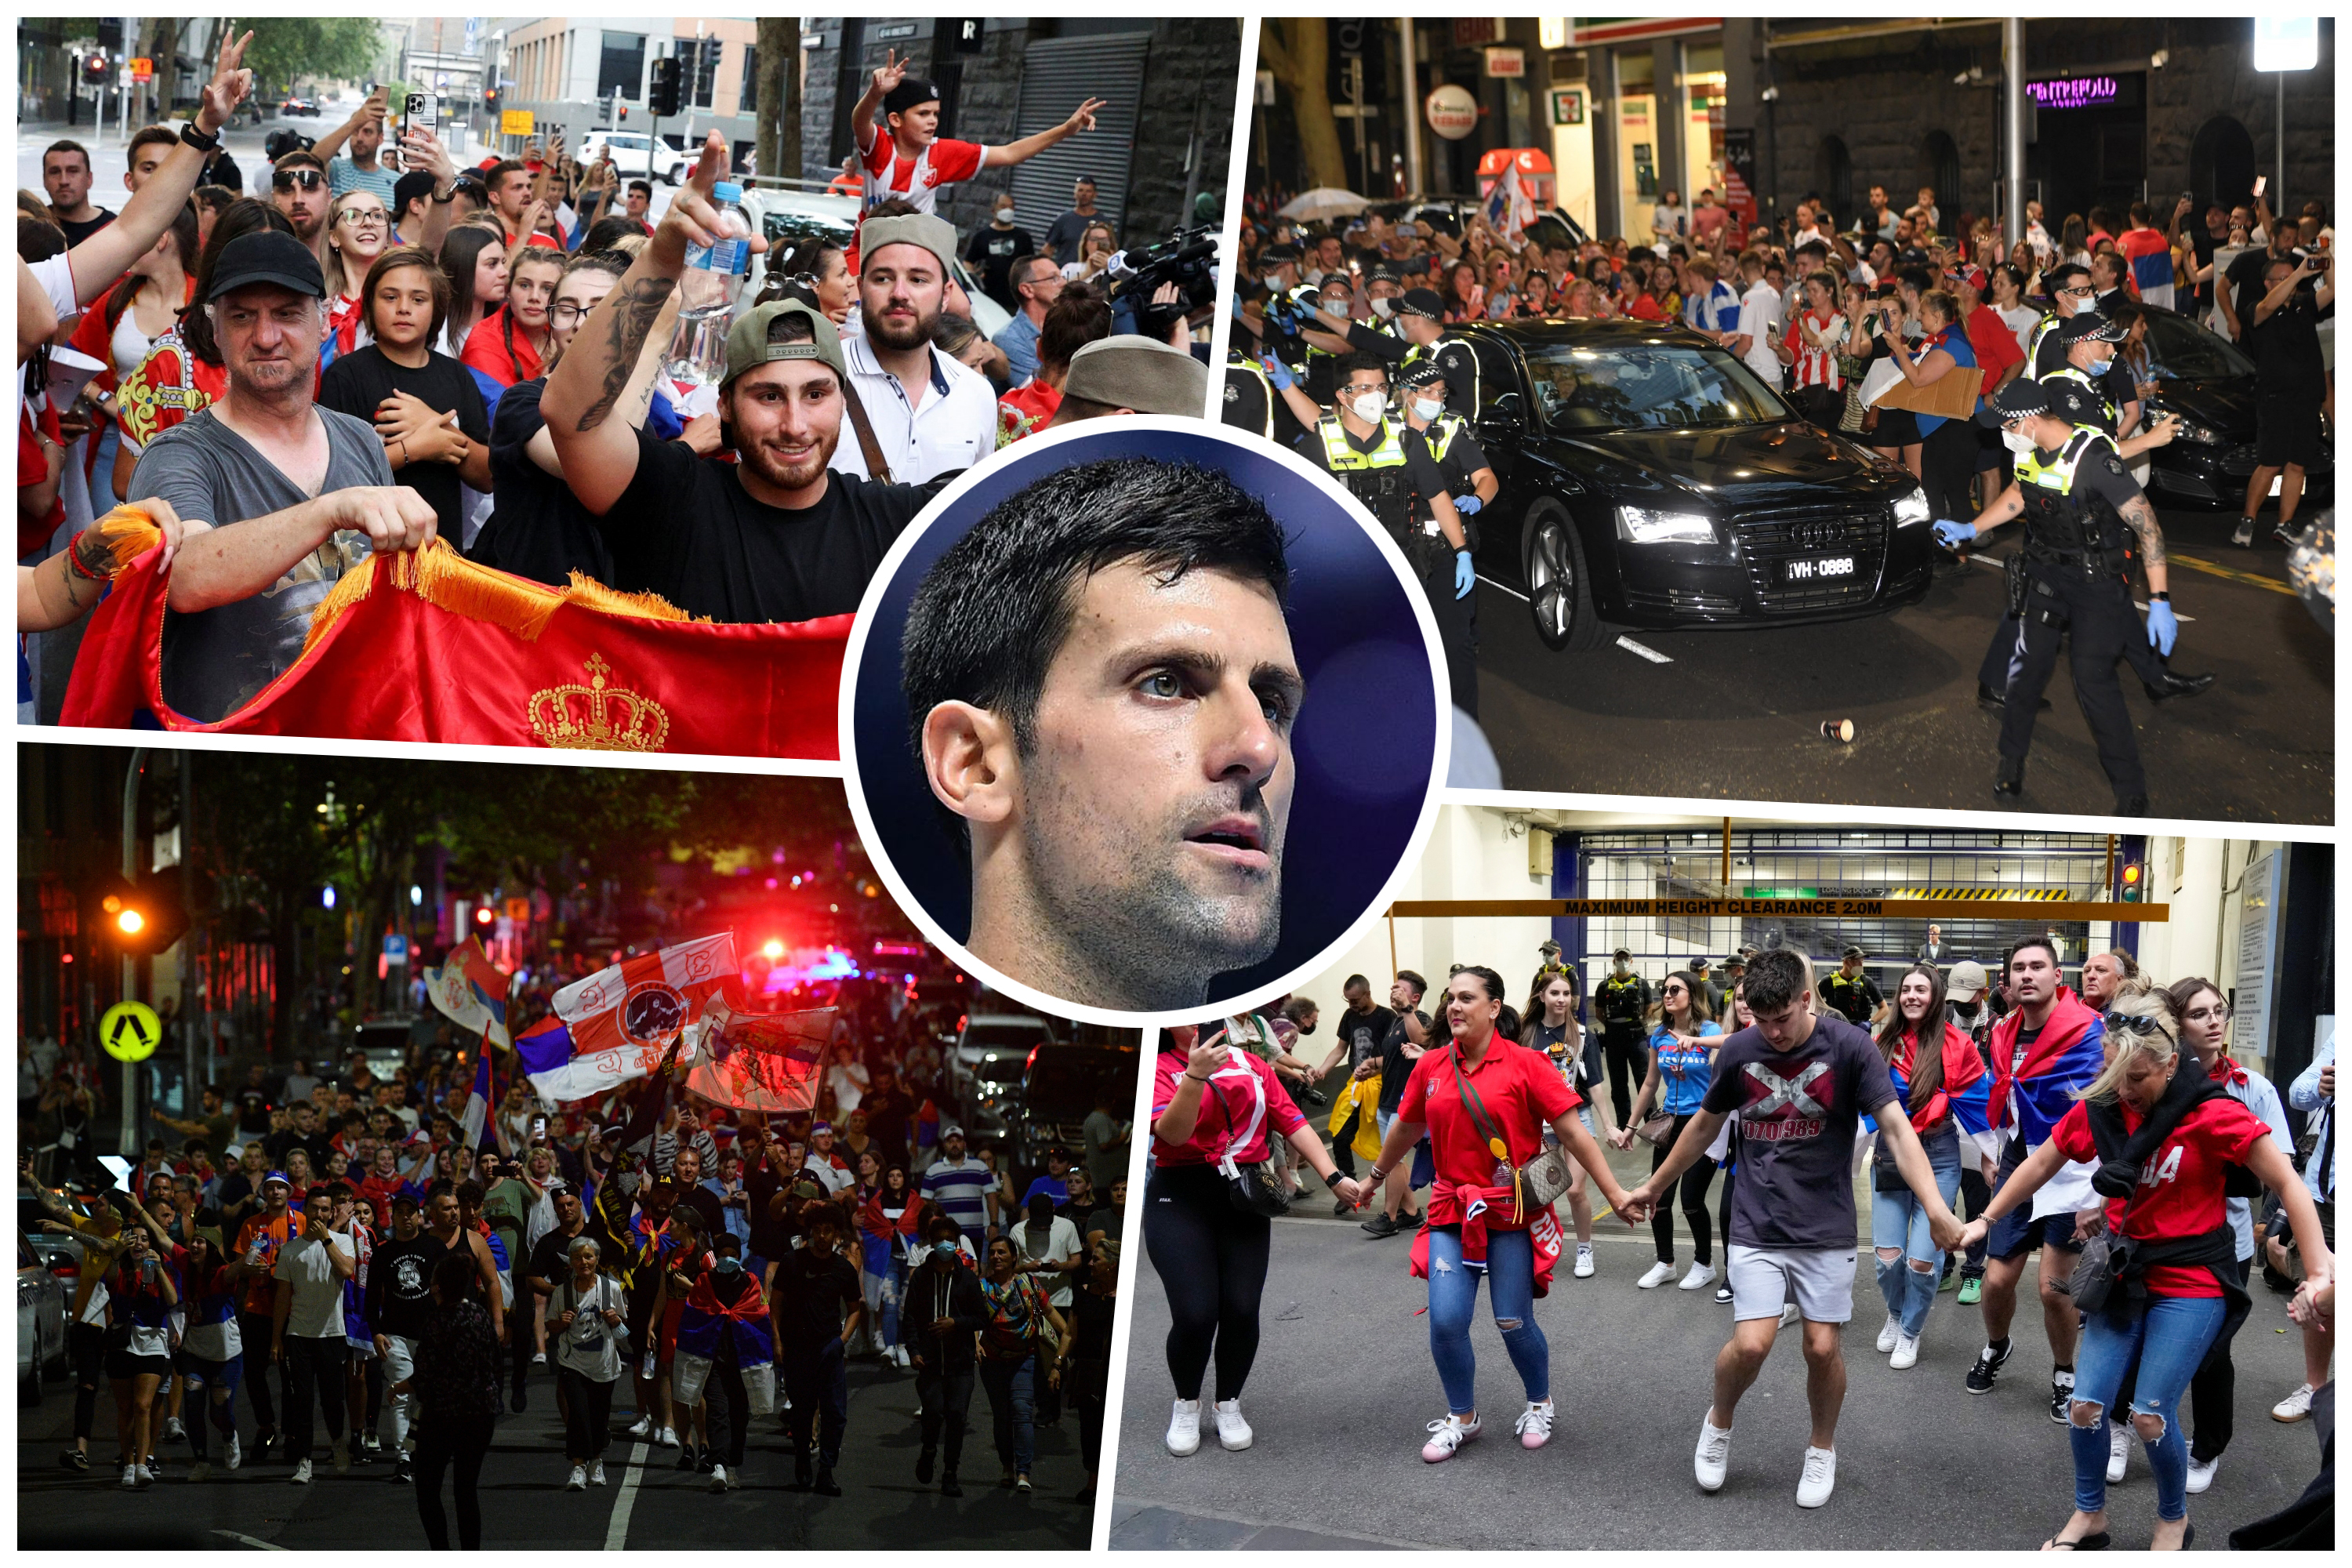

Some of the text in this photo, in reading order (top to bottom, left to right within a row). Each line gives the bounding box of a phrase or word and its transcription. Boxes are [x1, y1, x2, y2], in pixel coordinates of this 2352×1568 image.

[963, 20, 976, 39] R
[1565, 900, 1882, 915] MAXIMUM HEIGHT CLEARANCE 2.0M
[659, 1174, 671, 1184] LA
